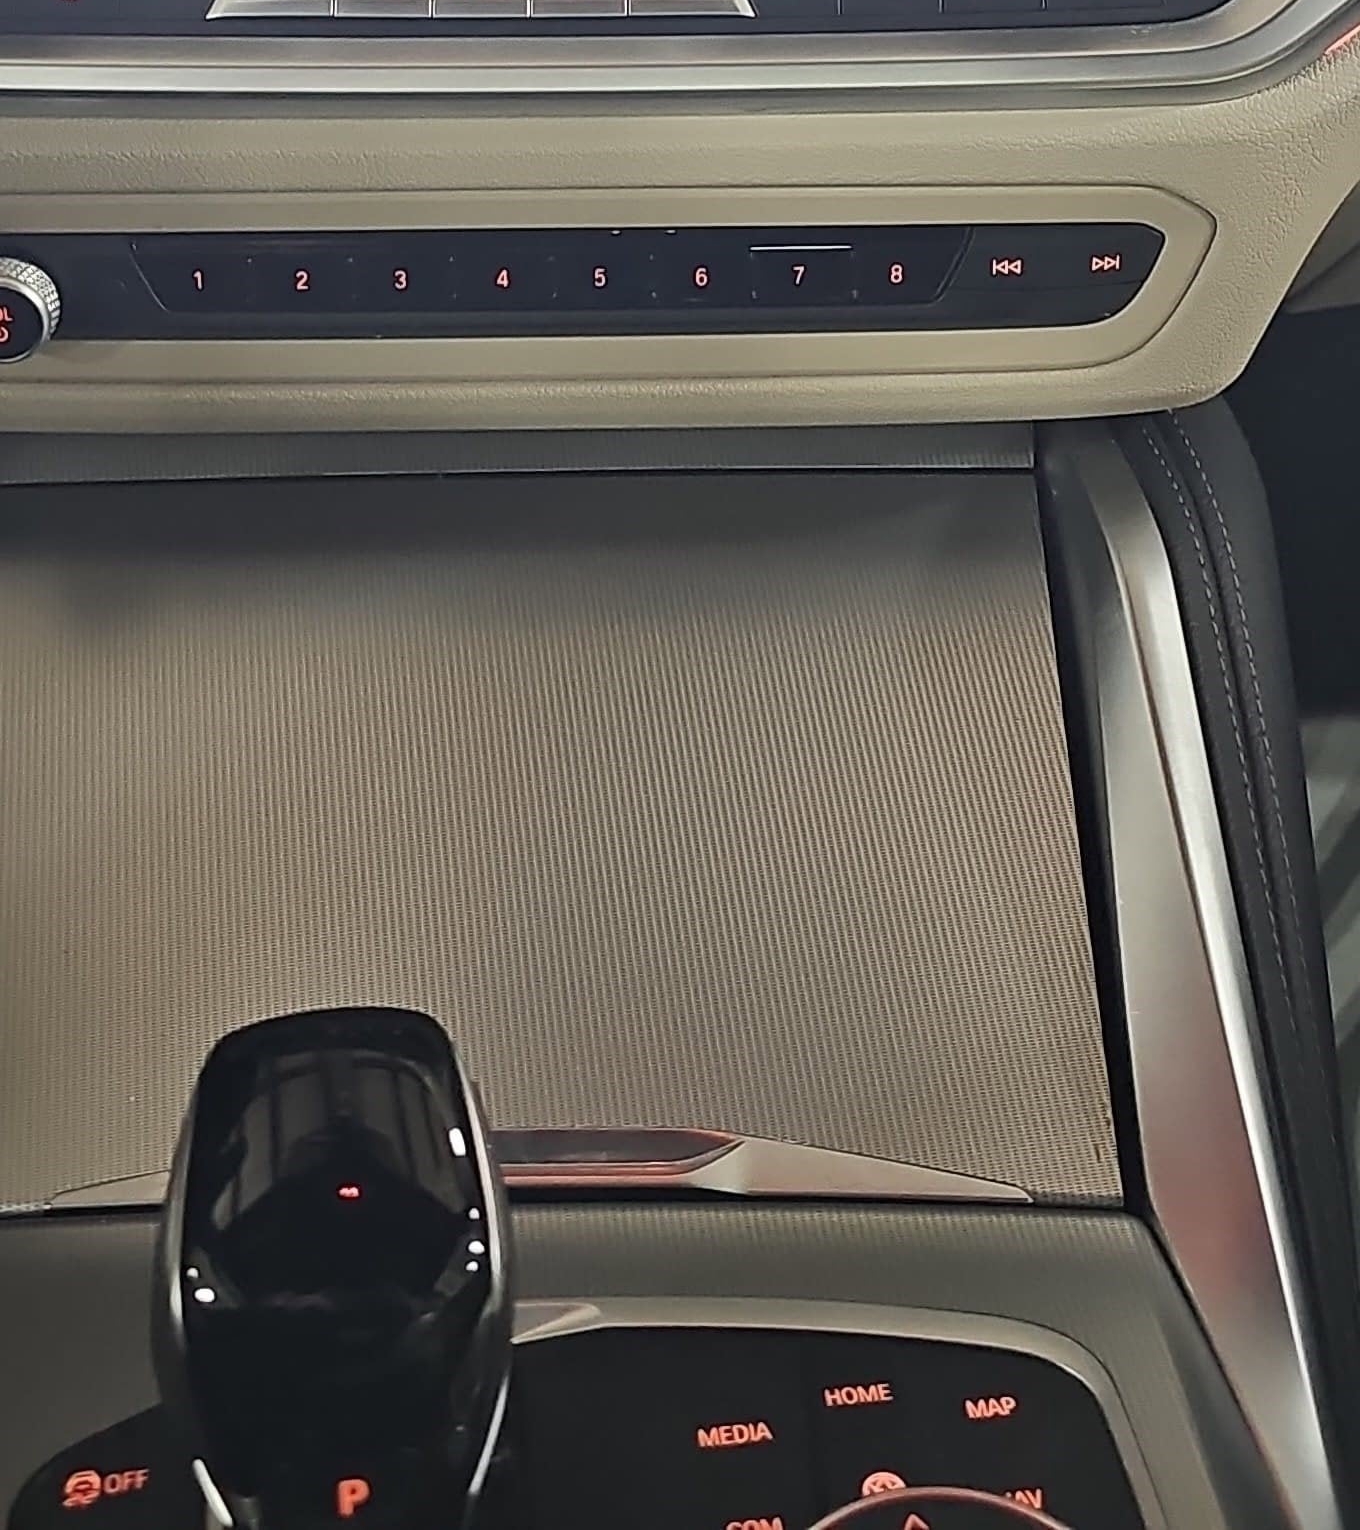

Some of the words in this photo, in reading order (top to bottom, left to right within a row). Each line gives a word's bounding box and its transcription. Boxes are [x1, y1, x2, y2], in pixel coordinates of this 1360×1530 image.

[193, 271, 203, 289] 1
[295, 271, 310, 290] 2
[393, 271, 408, 290] 3
[495, 269, 510, 288] 4
[593, 268, 606, 288] 5
[694, 267, 708, 288] 6
[792, 265, 806, 285] 7
[889, 264, 903, 285] 8
[824, 1383, 893, 1407] HOME
[965, 1396, 1017, 1419] MAP
[697, 1421, 773, 1448] MEDIA
[103, 1469, 149, 1495] OFF
[336, 1477, 371, 1518] P
[1006, 1488, 1042, 1509] AV
